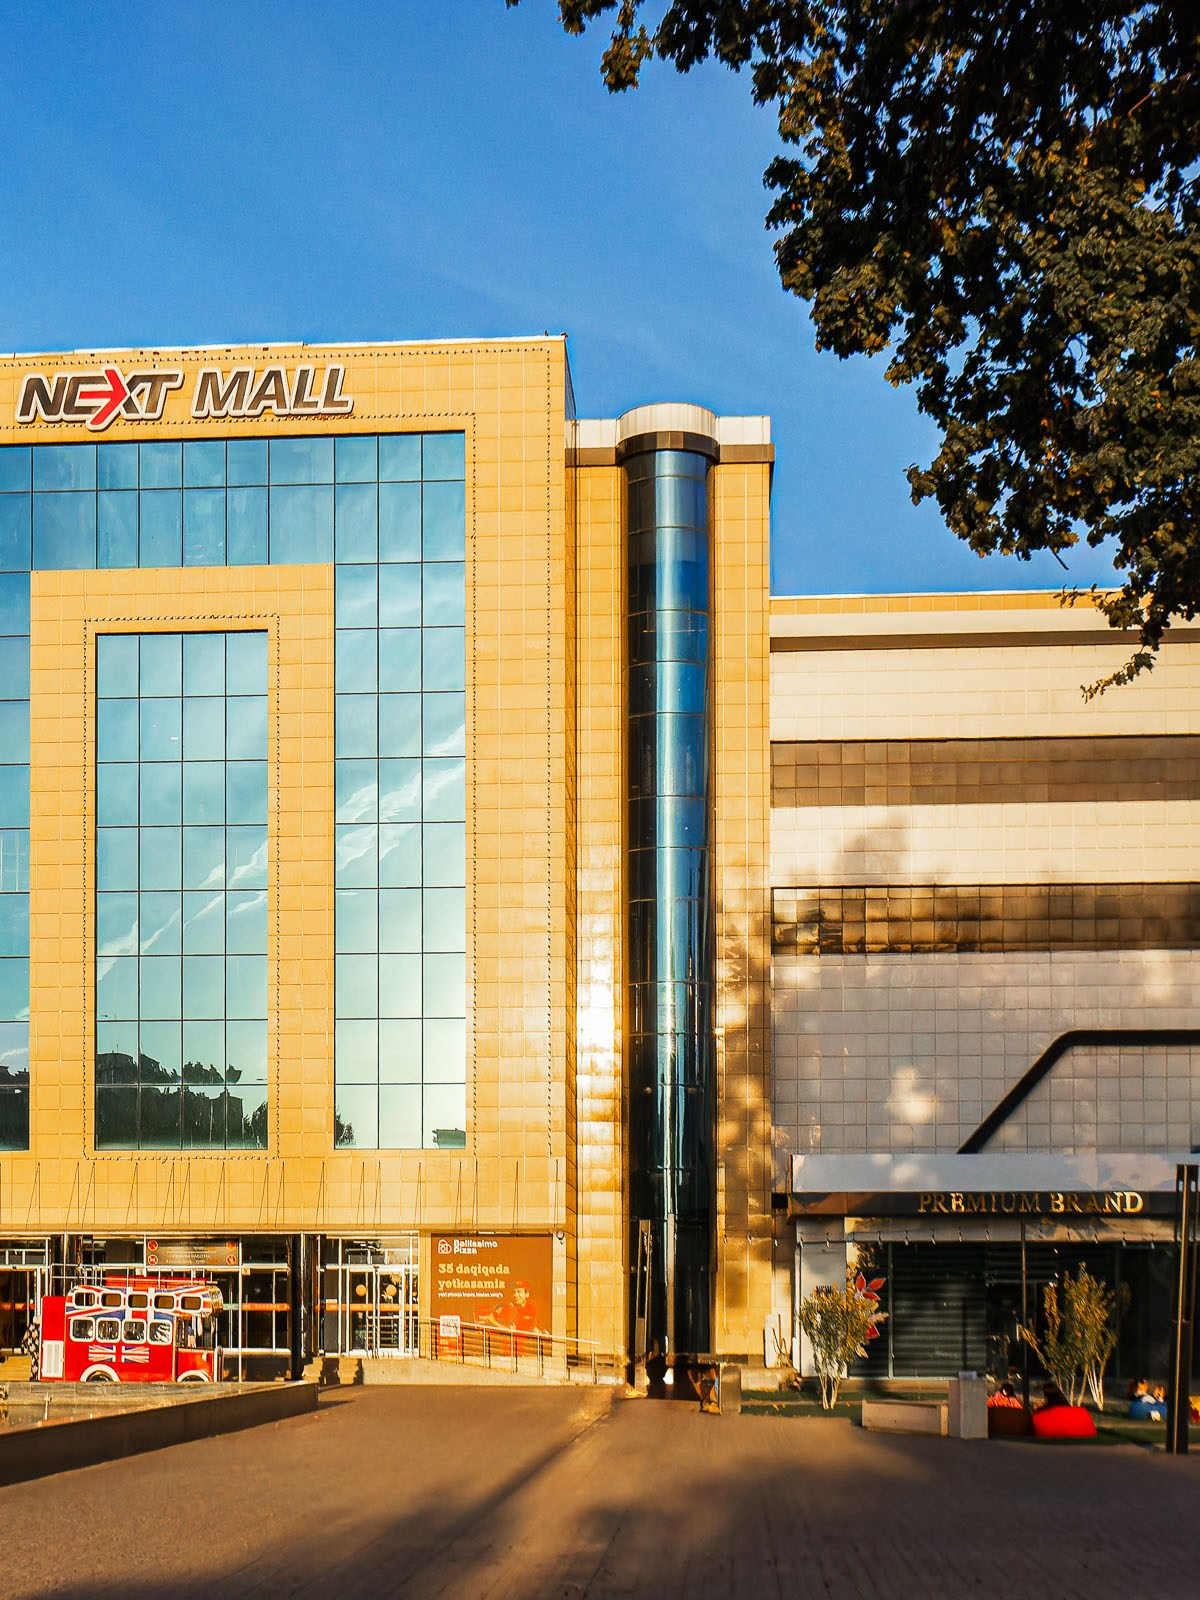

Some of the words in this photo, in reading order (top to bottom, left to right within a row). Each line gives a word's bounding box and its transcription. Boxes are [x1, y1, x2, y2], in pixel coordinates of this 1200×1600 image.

[17, 366, 184, 431] NEXT
[191, 364, 353, 418] MALL
[917, 1192, 1042, 1214] PREMIUM
[1050, 1191, 1144, 1214] BRAND
[453, 1239, 498, 1248] Bellissimo
[453, 1247, 478, 1255] Pizza
[438, 1263, 454, 1274] 35
[455, 1263, 510, 1276] daqiqada
[438, 1278, 506, 1290] yetkazamiz
